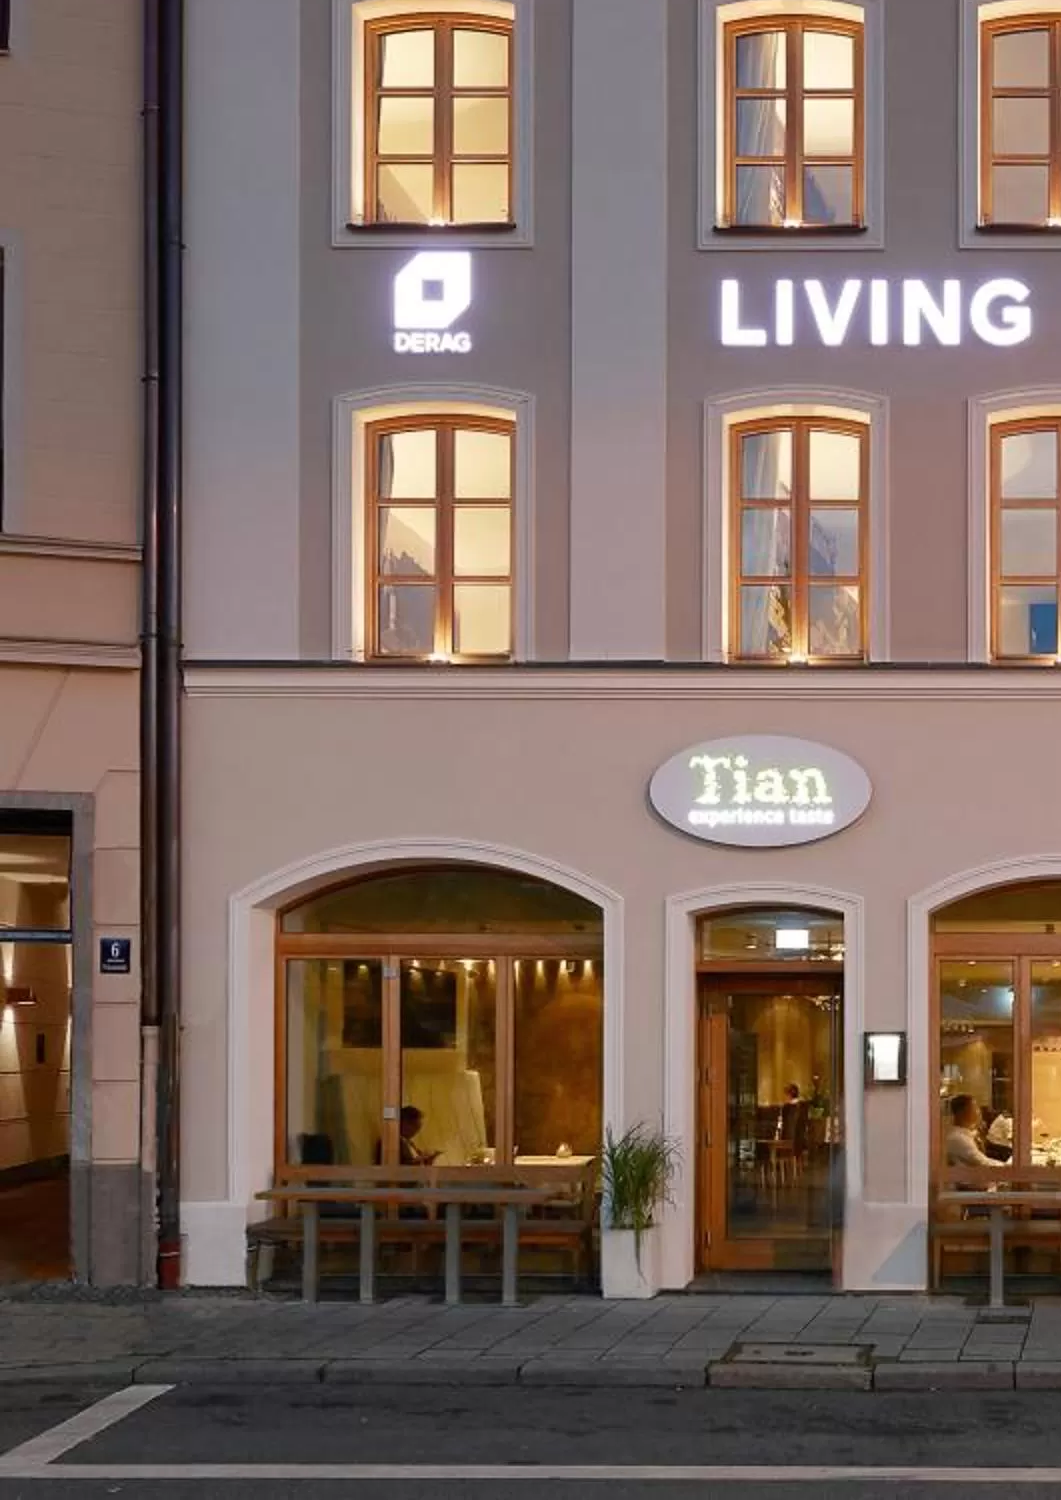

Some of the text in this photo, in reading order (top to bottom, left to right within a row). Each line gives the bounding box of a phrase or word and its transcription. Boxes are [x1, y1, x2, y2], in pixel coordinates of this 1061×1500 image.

[720, 277, 1032, 347] LIVING
[394, 331, 472, 353] DERAG
[688, 754, 833, 805] Tian
[111, 941, 120, 958] 6
